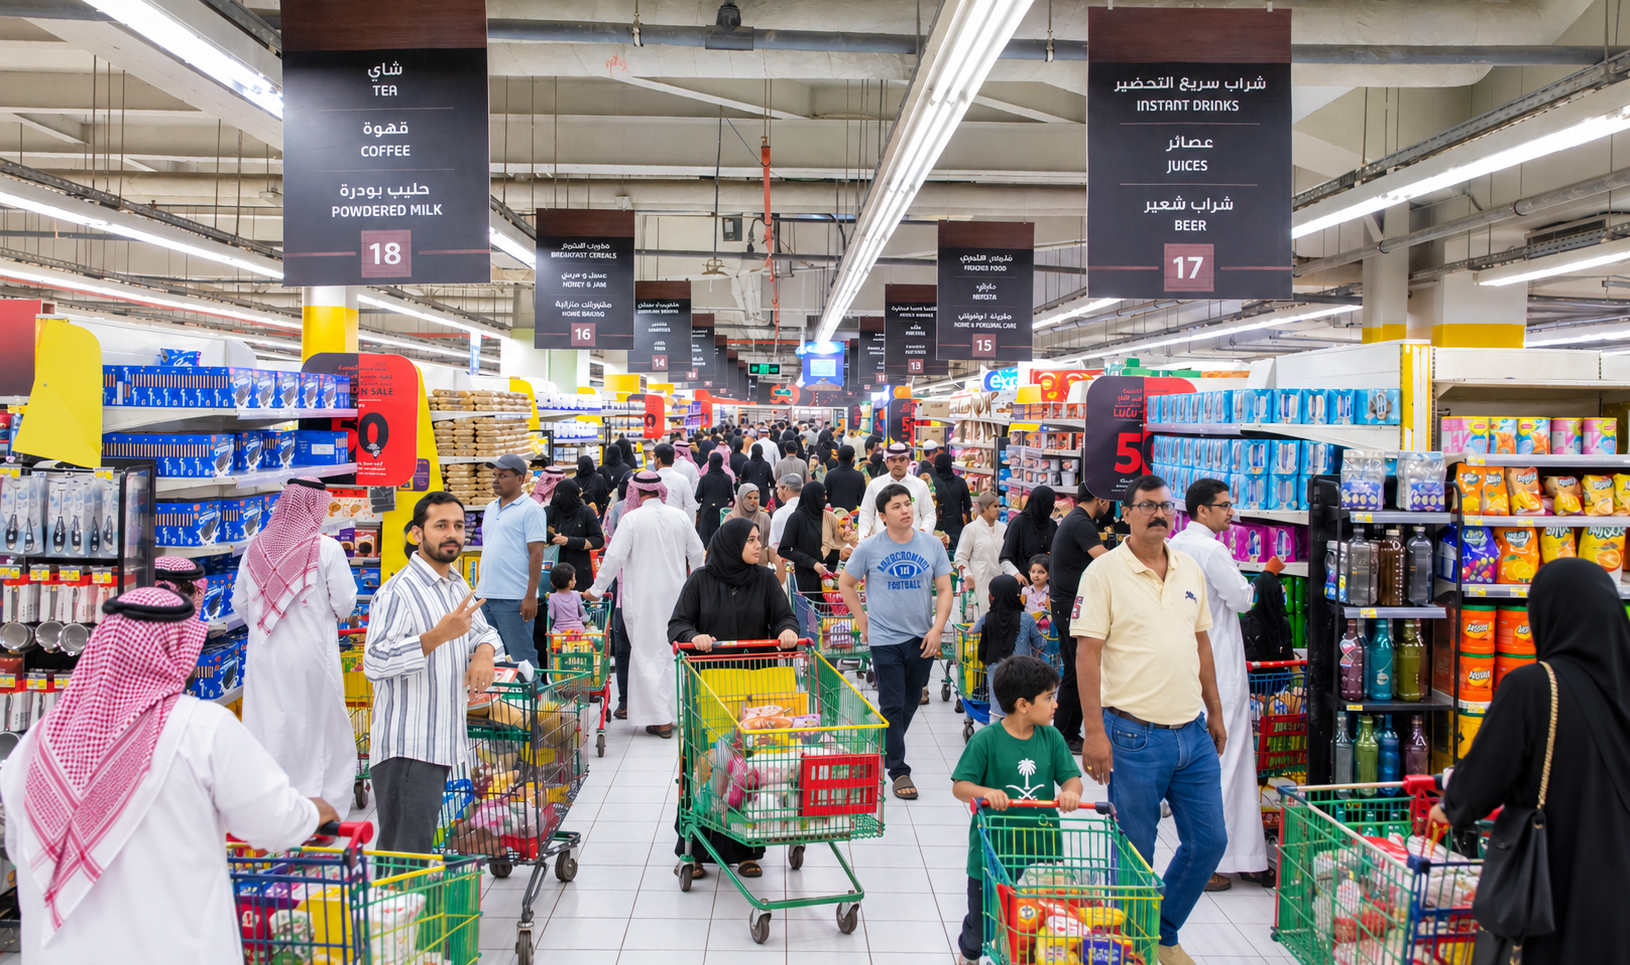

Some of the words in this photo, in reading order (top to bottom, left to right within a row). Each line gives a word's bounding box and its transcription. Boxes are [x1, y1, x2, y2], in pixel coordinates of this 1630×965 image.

[367, 61, 403, 82] شاي
[372, 85, 398, 97] TEA
[1113, 77, 1174, 92] التحضير
[1179, 77, 1220, 92] سريع
[1224, 76, 1266, 93] شراب
[1137, 99, 1190, 112] INSTANT
[1193, 100, 1240, 112] DRINKS
[362, 121, 409, 138] قهوة
[360, 144, 411, 158] COFFEE
[1165, 135, 1214, 152] عصائر
[1166, 159, 1208, 174] JUICES
[339, 183, 383, 200] بودرة
[387, 183, 430, 200] حليب
[331, 204, 407, 218] POWDERED
[409, 204, 443, 217] MILK
[1143, 195, 1186, 214] شعير
[1190, 195, 1234, 213] شراب
[1174, 219, 1207, 231] BEER
[369, 242, 402, 265] 18
[1172, 256, 1204, 279] 17
[573, 327, 592, 341] 16
[976, 339, 993, 352] 15
[654, 358, 666, 367] 14
[370, 387, 394, 396] SALE
